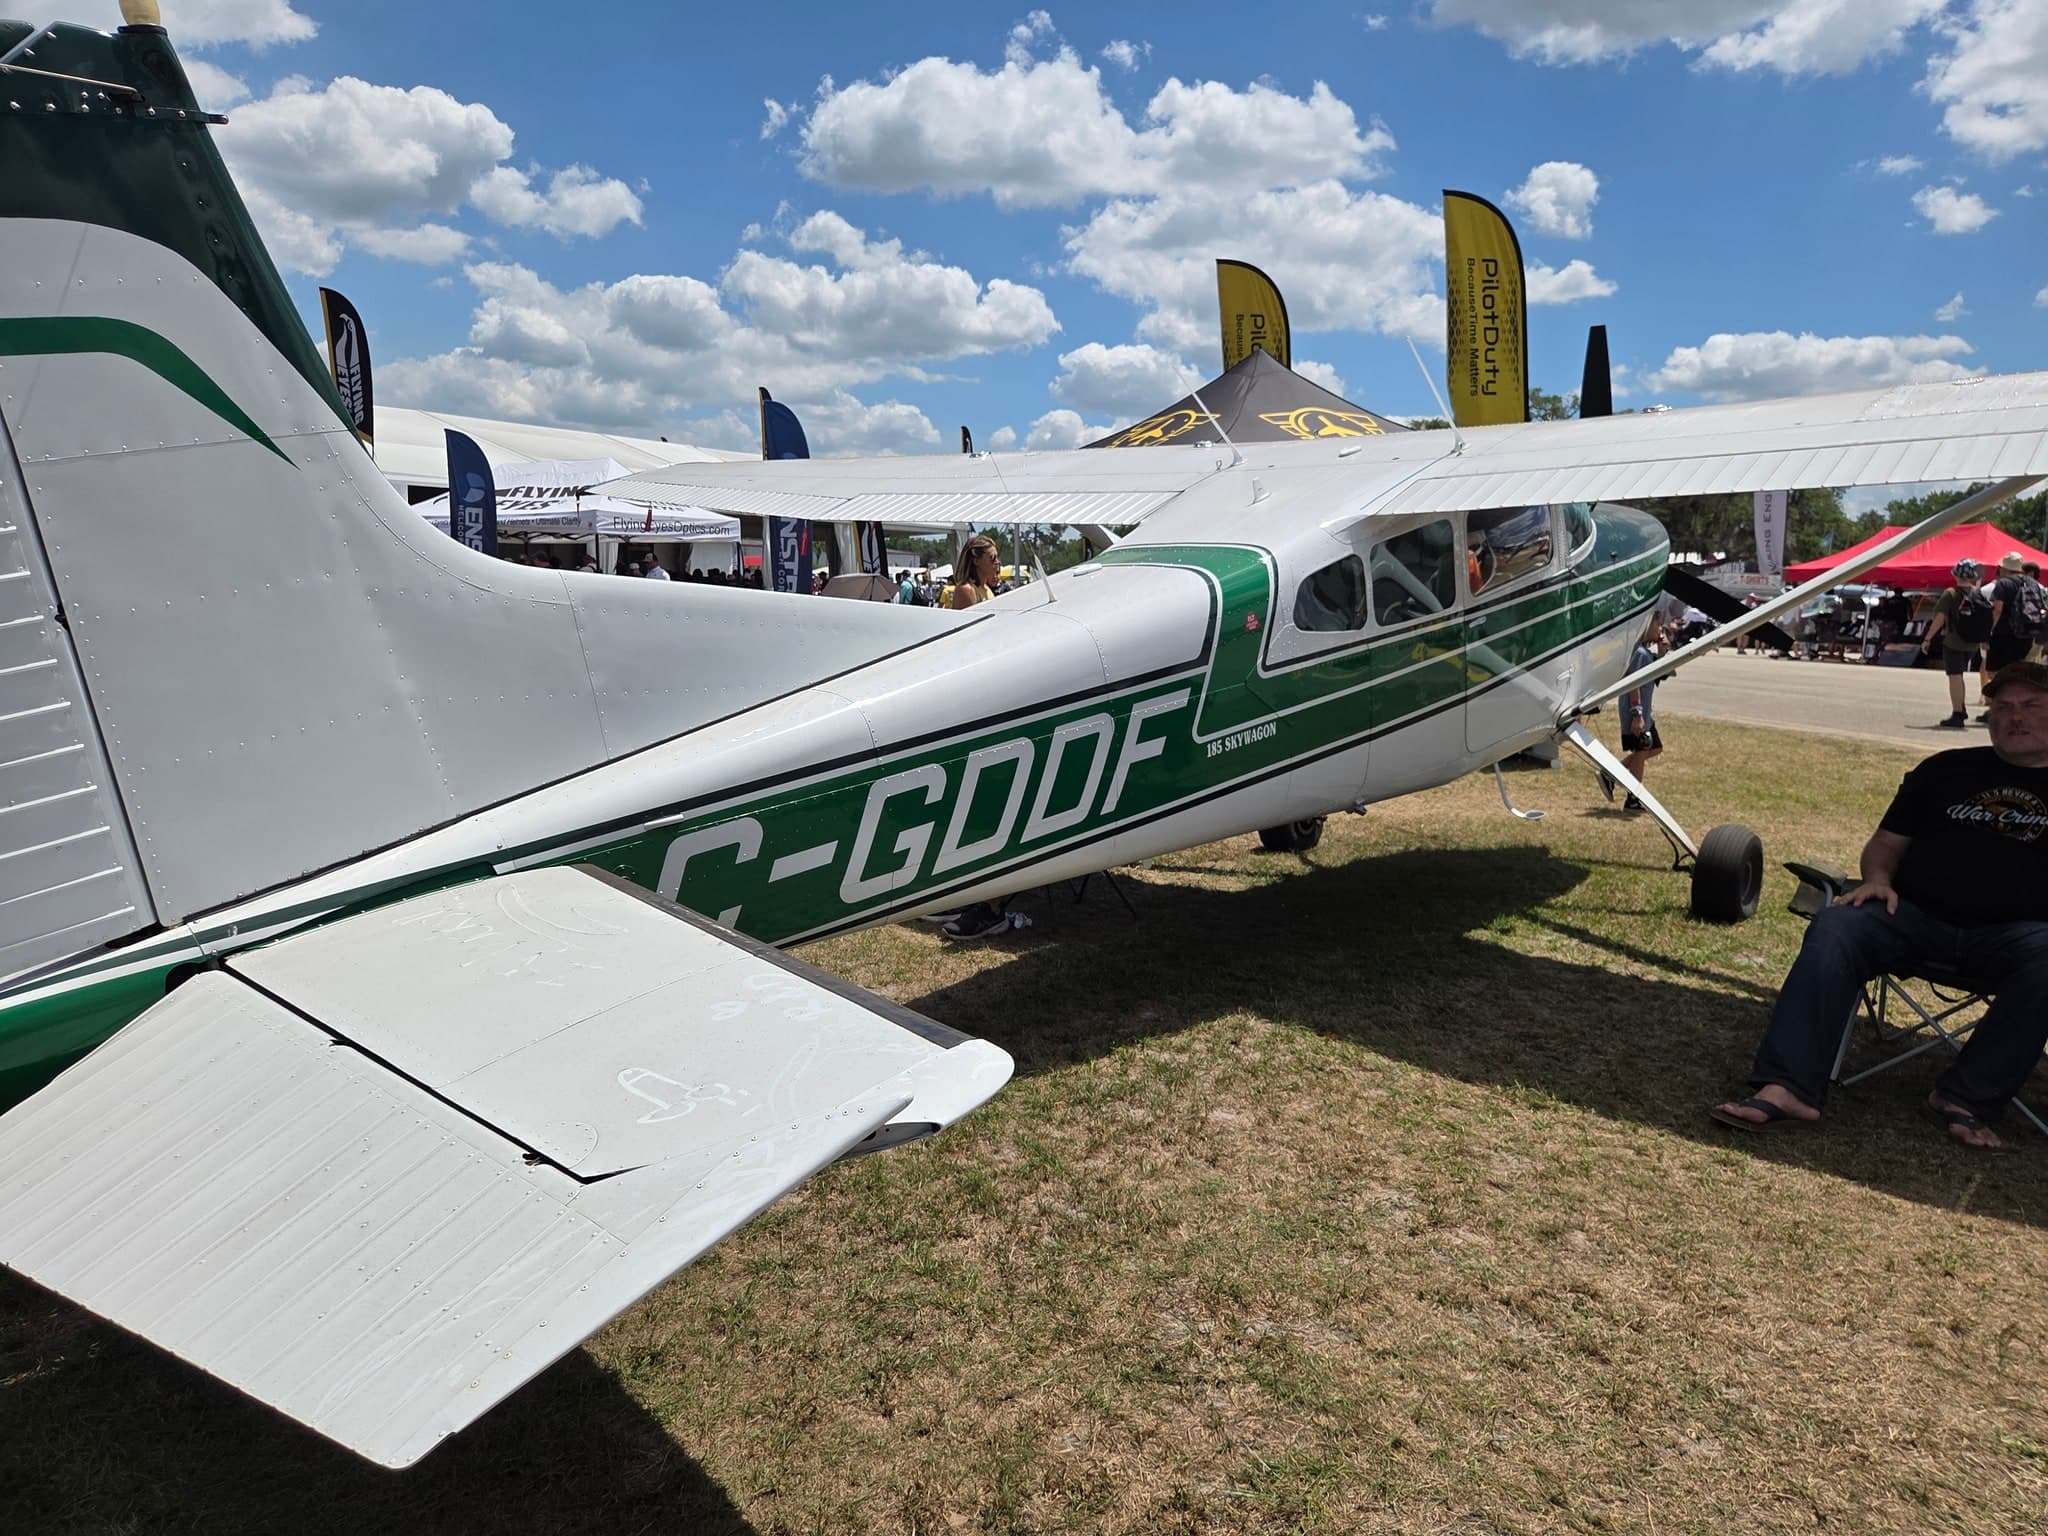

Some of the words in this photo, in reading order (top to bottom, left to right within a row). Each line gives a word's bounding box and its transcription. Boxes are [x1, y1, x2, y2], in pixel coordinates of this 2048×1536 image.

[1481, 258, 1499, 396] PilotDuty
[350, 364, 365, 426] FLYING
[1469, 348, 1480, 397] Matters
[508, 485, 578, 499] FLYIN
[1206, 739, 1223, 758] 185
[1224, 721, 1277, 752] SKYWAGON
[657, 687, 1191, 931] C-GDDF
[1946, 803, 1996, 822] War
